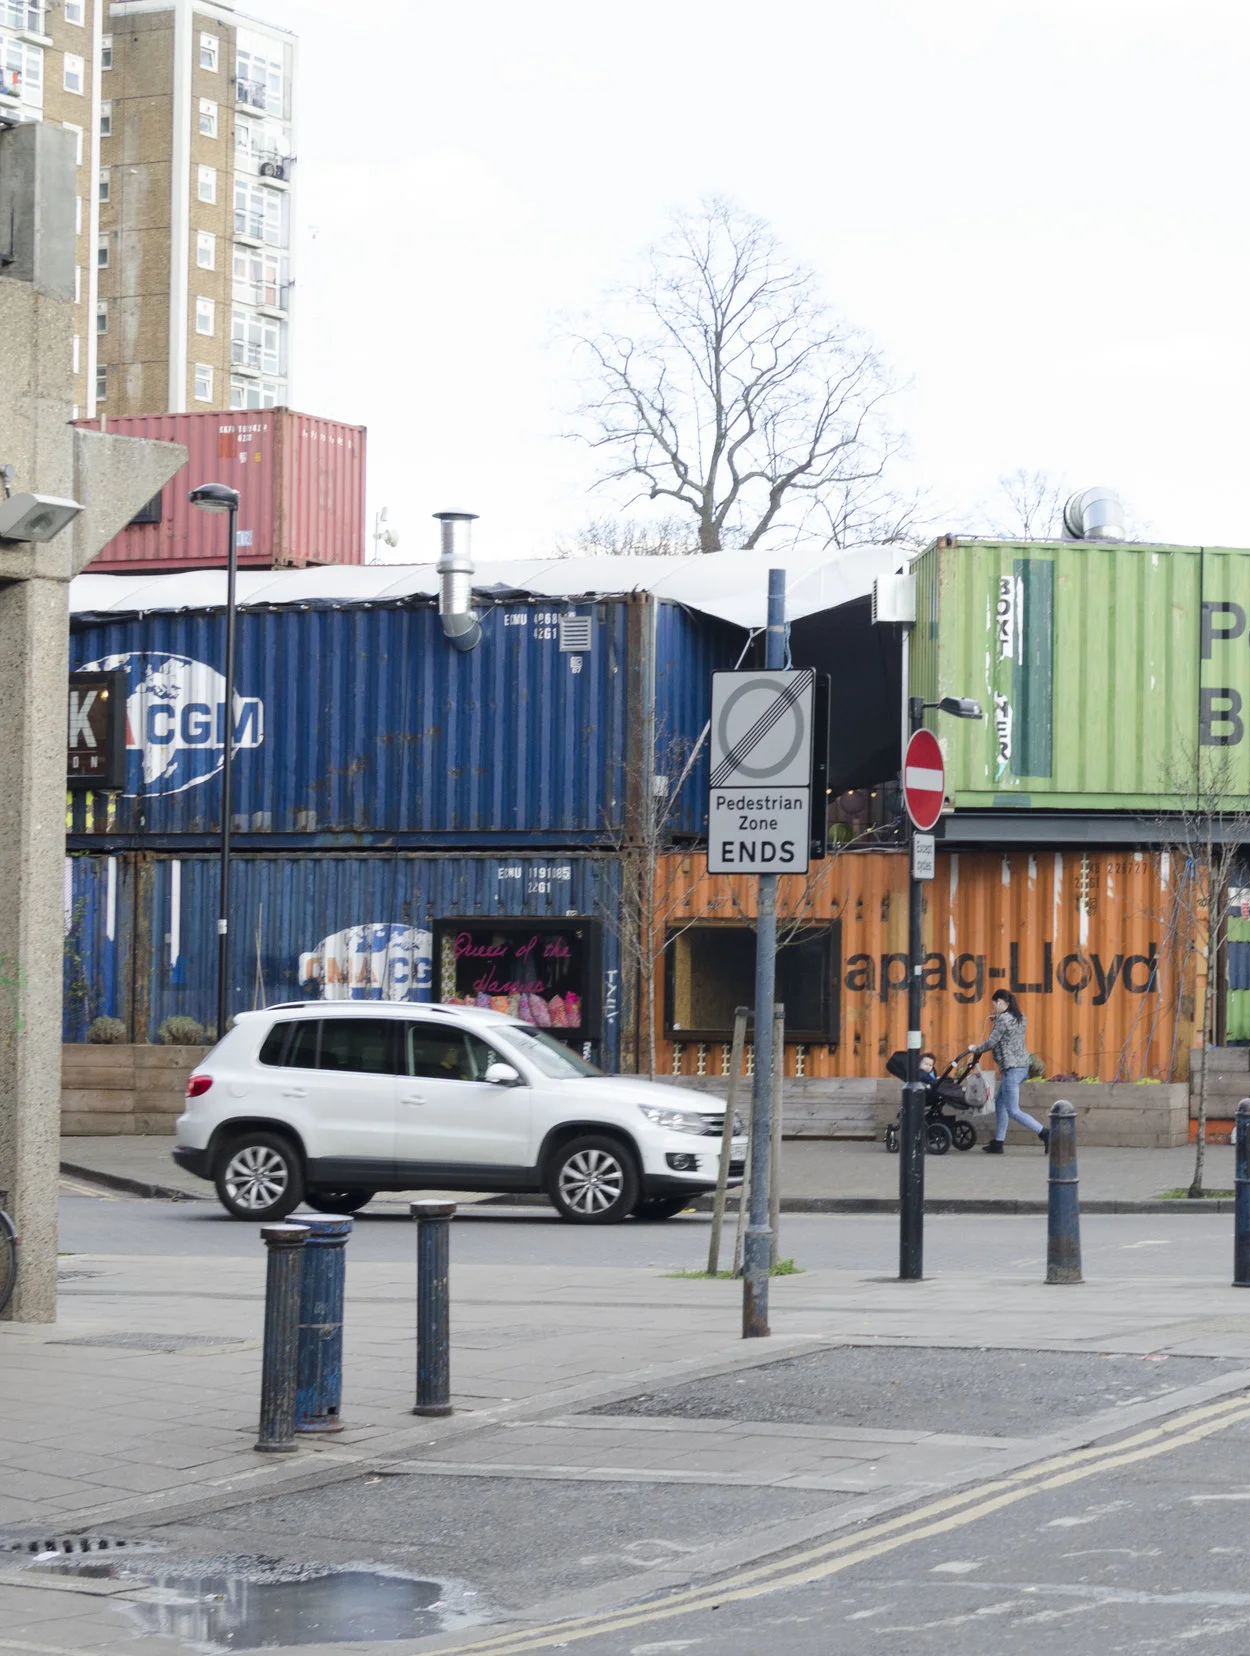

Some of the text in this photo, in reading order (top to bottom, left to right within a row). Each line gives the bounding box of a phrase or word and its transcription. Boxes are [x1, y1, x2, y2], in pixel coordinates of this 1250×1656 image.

[146, 702, 259, 746] CGM
[716, 795, 803, 811] Pedestrian
[739, 815, 778, 831] Zone
[721, 840, 796, 863] ENDS
[514, 935, 538, 964] of
[543, 936, 572, 958] the
[388, 956, 433, 984] CG
